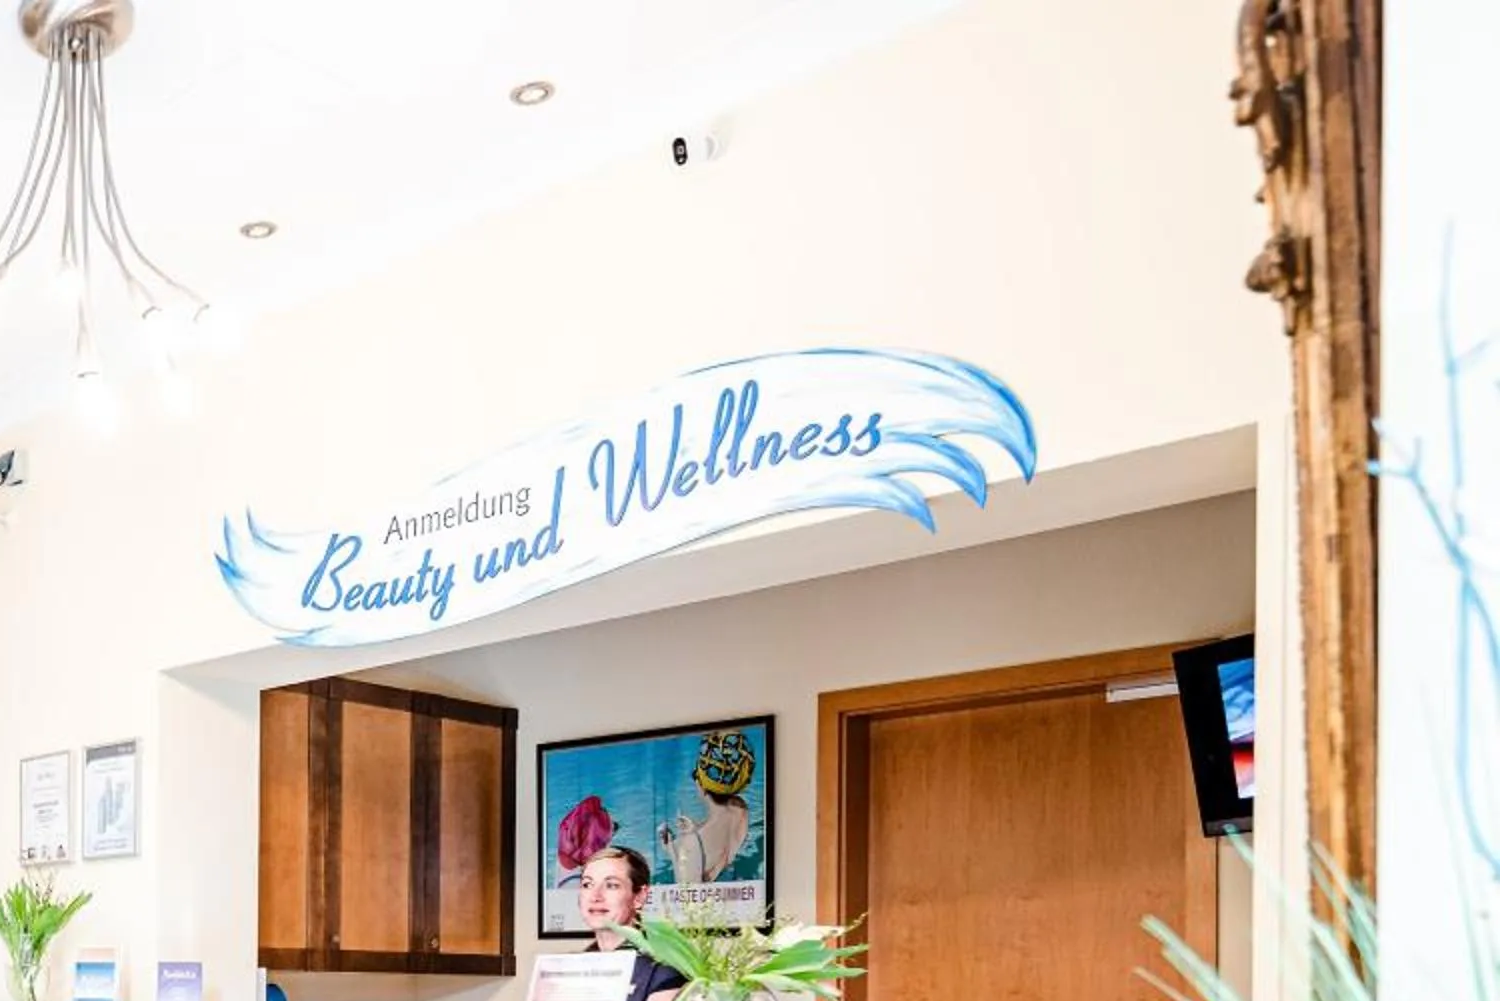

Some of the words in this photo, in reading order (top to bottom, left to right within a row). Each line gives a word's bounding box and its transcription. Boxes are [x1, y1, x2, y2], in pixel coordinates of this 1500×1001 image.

[301, 533, 456, 621] Beauty
[473, 466, 564, 583] und
[588, 379, 882, 527] Wellness
[383, 486, 531, 544] Anmeldung
